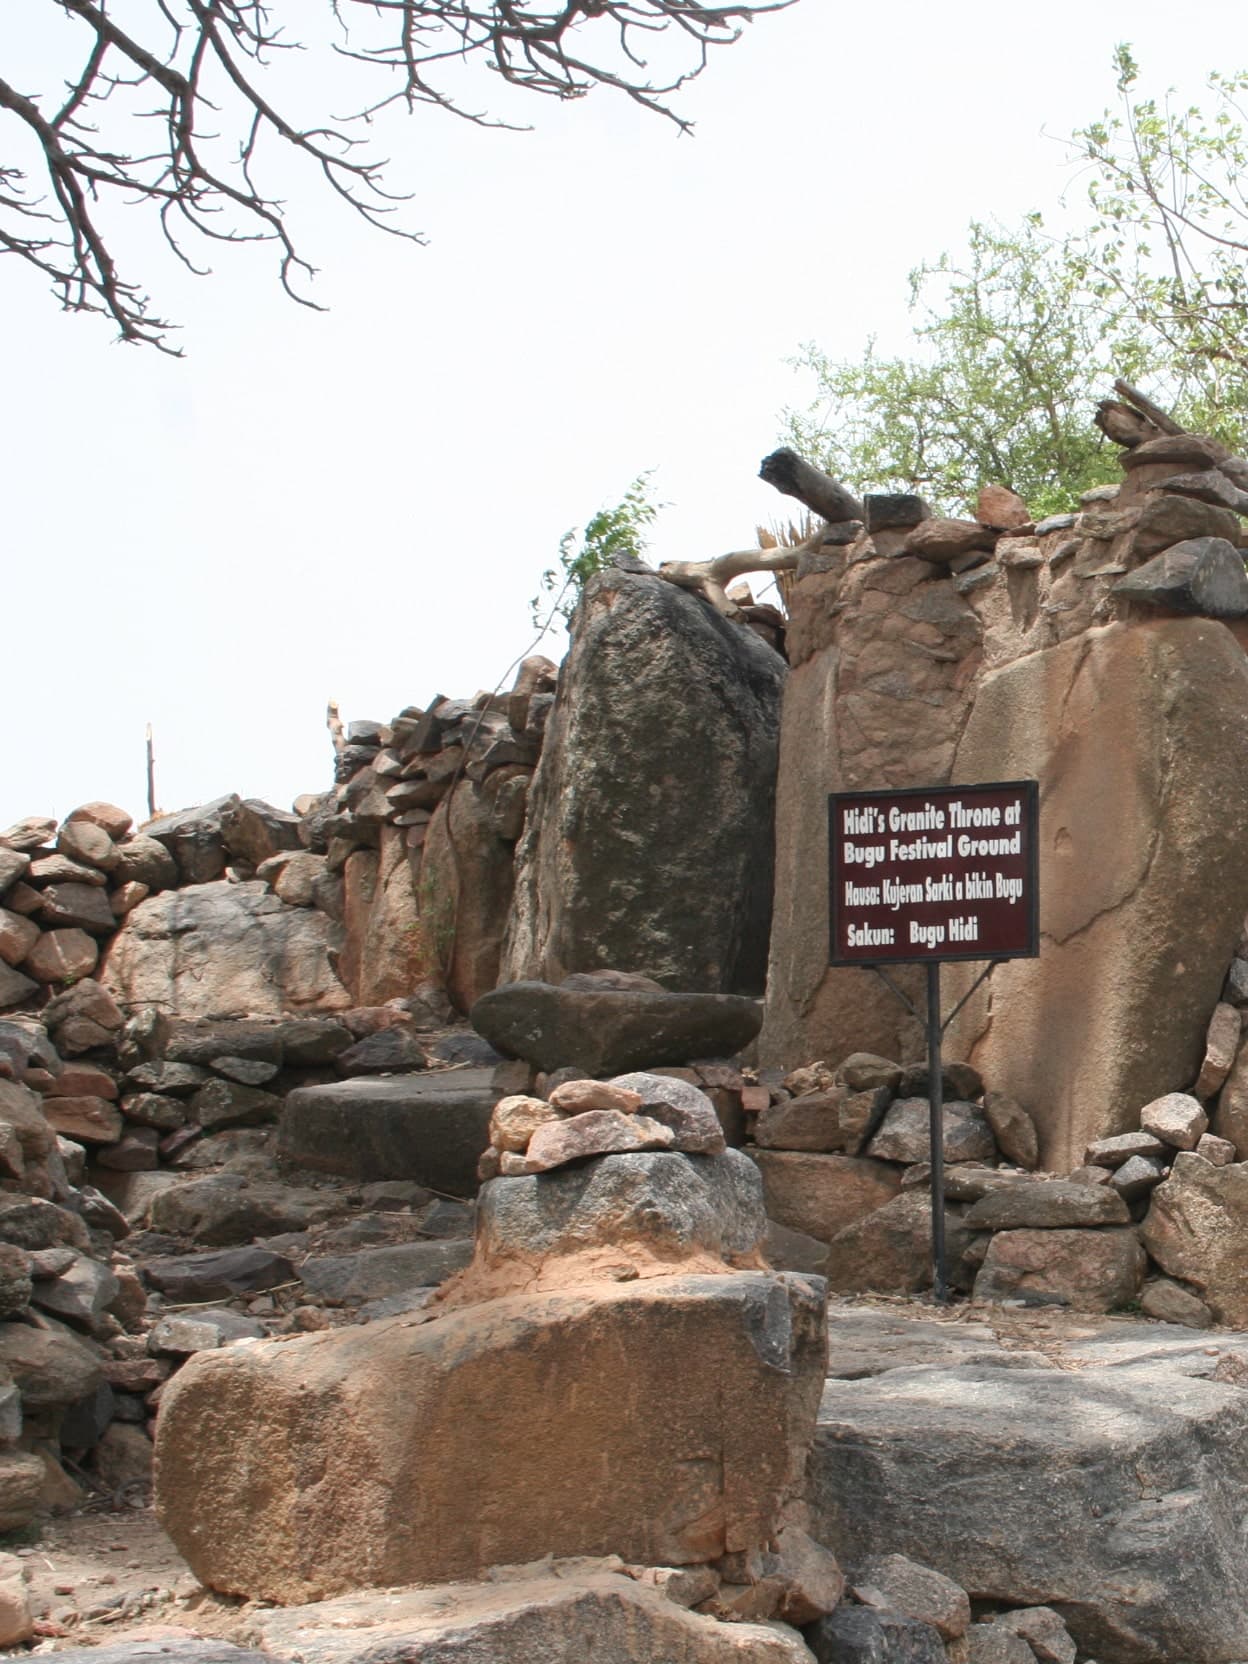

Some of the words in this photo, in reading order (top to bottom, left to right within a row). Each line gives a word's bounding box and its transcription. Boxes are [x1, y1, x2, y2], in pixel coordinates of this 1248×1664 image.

[844, 807, 885, 835] Hidi's
[889, 803, 945, 832] Granite
[949, 801, 1000, 829] Throne
[1005, 800, 1021, 825] at
[844, 842, 885, 868] Bugu
[890, 834, 952, 861] Festival
[958, 831, 1021, 857] Ground
[845, 881, 880, 906] Hausa:
[883, 877, 923, 911] Kujeran
[925, 874, 953, 902] Sarki
[956, 882, 963, 900] a
[965, 872, 993, 900] bikin
[996, 873, 1023, 904] Bugu
[847, 922, 894, 947] Sakun:
[910, 921, 944, 949] Bugu
[949, 916, 978, 941] Hidi
